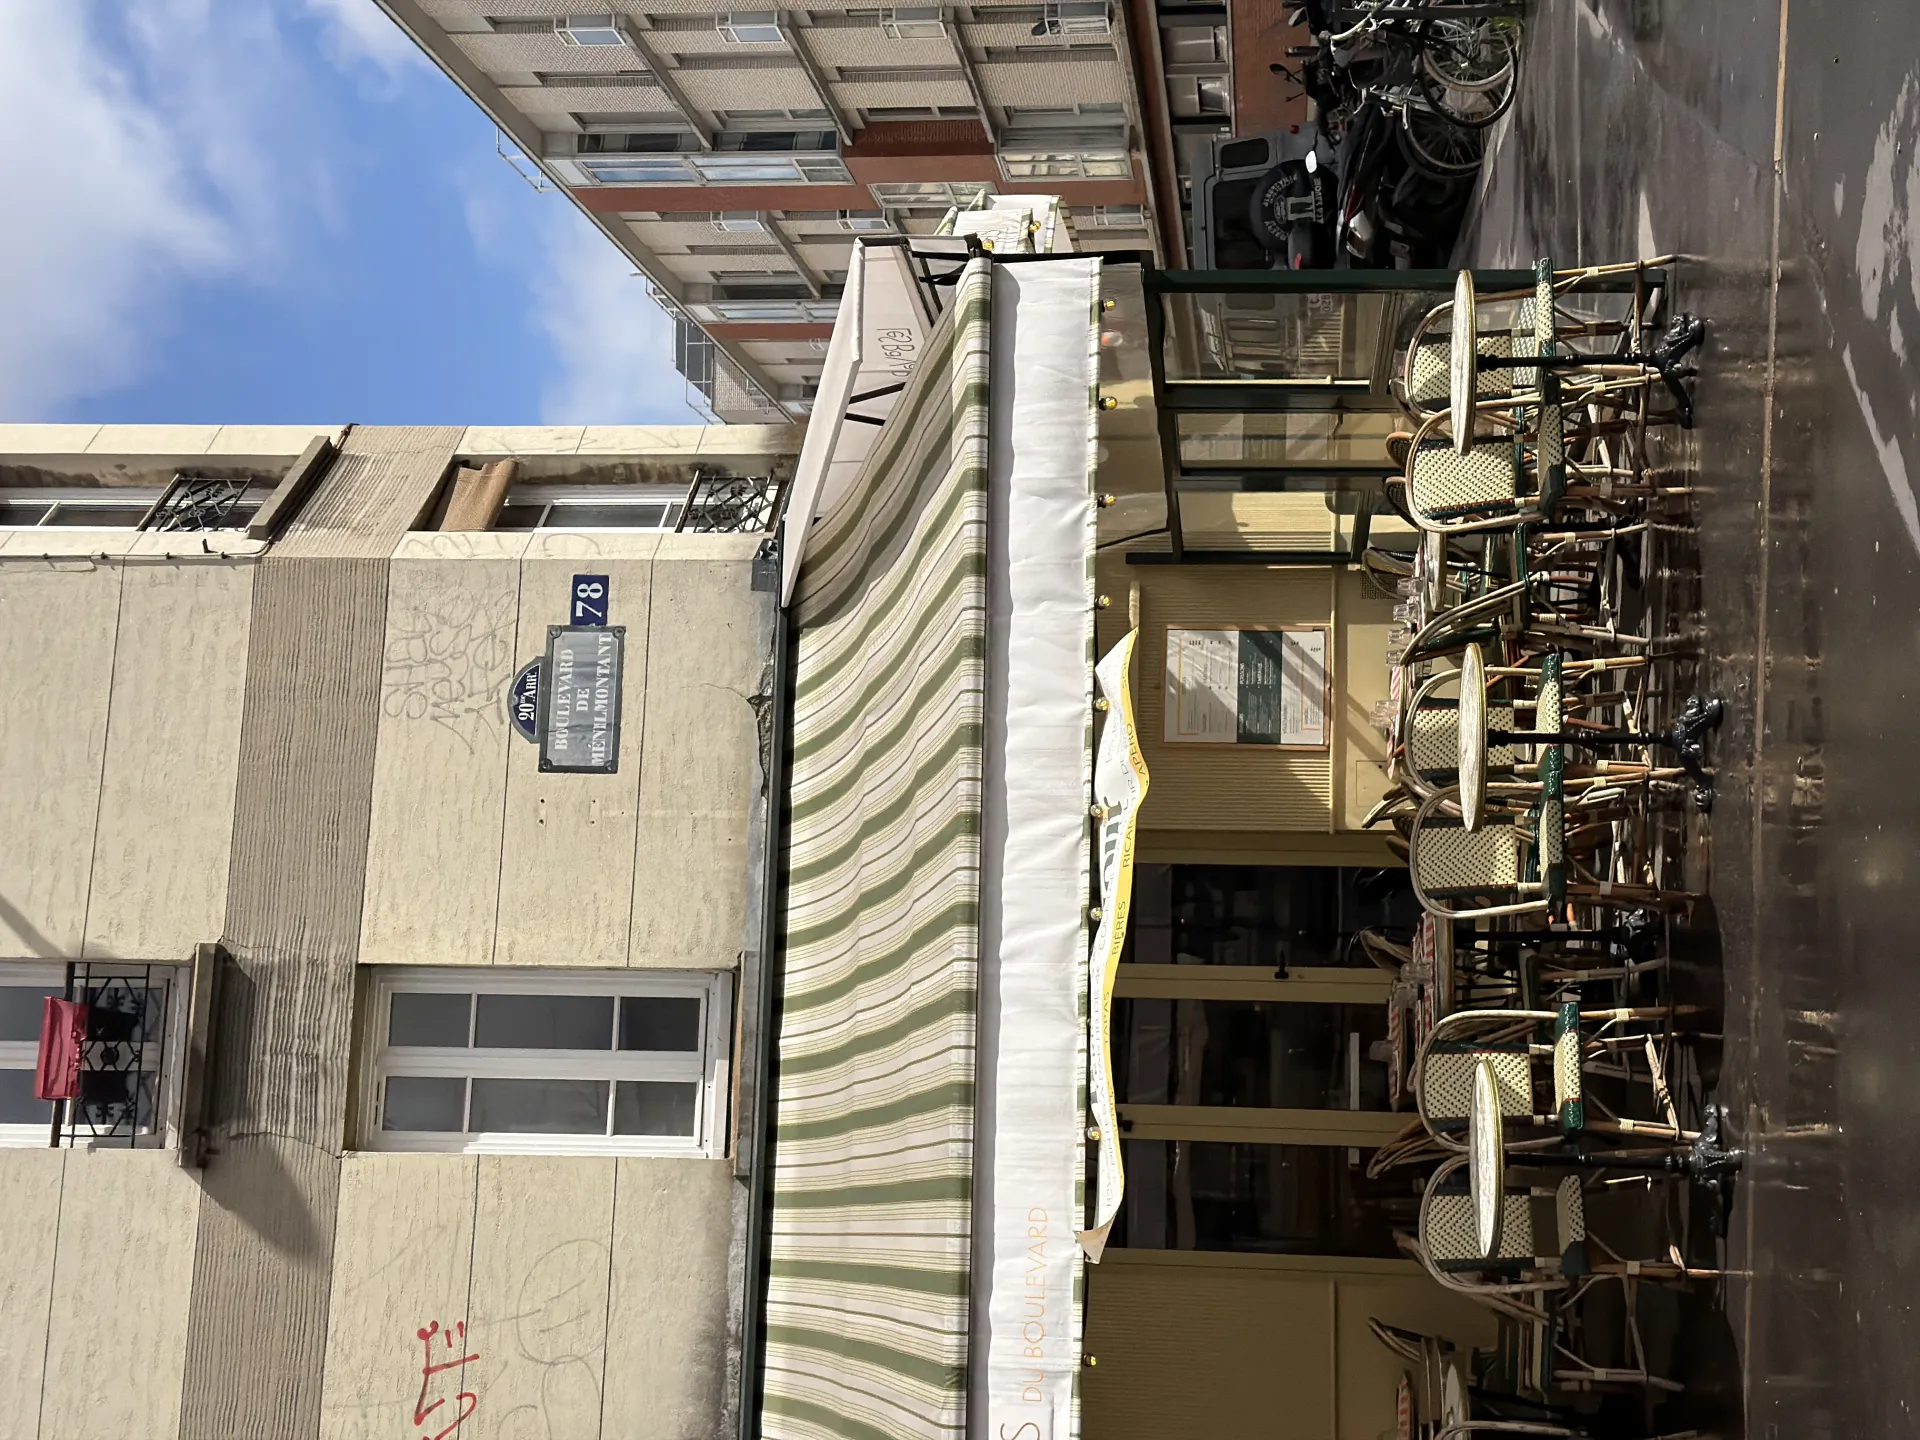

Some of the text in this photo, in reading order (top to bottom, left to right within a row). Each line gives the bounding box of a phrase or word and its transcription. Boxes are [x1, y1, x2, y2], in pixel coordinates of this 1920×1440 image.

[575, 582, 604, 618] 78
[554, 649, 574, 750] BOULEVARD
[576, 688, 590, 711] DE
[588, 632, 612, 765] MÉNILMONTANT
[1111, 900, 1126, 955] BIÈRES
[1022, 1207, 1049, 1358] BOULEVARD
[1021, 1368, 1044, 1402] DU
